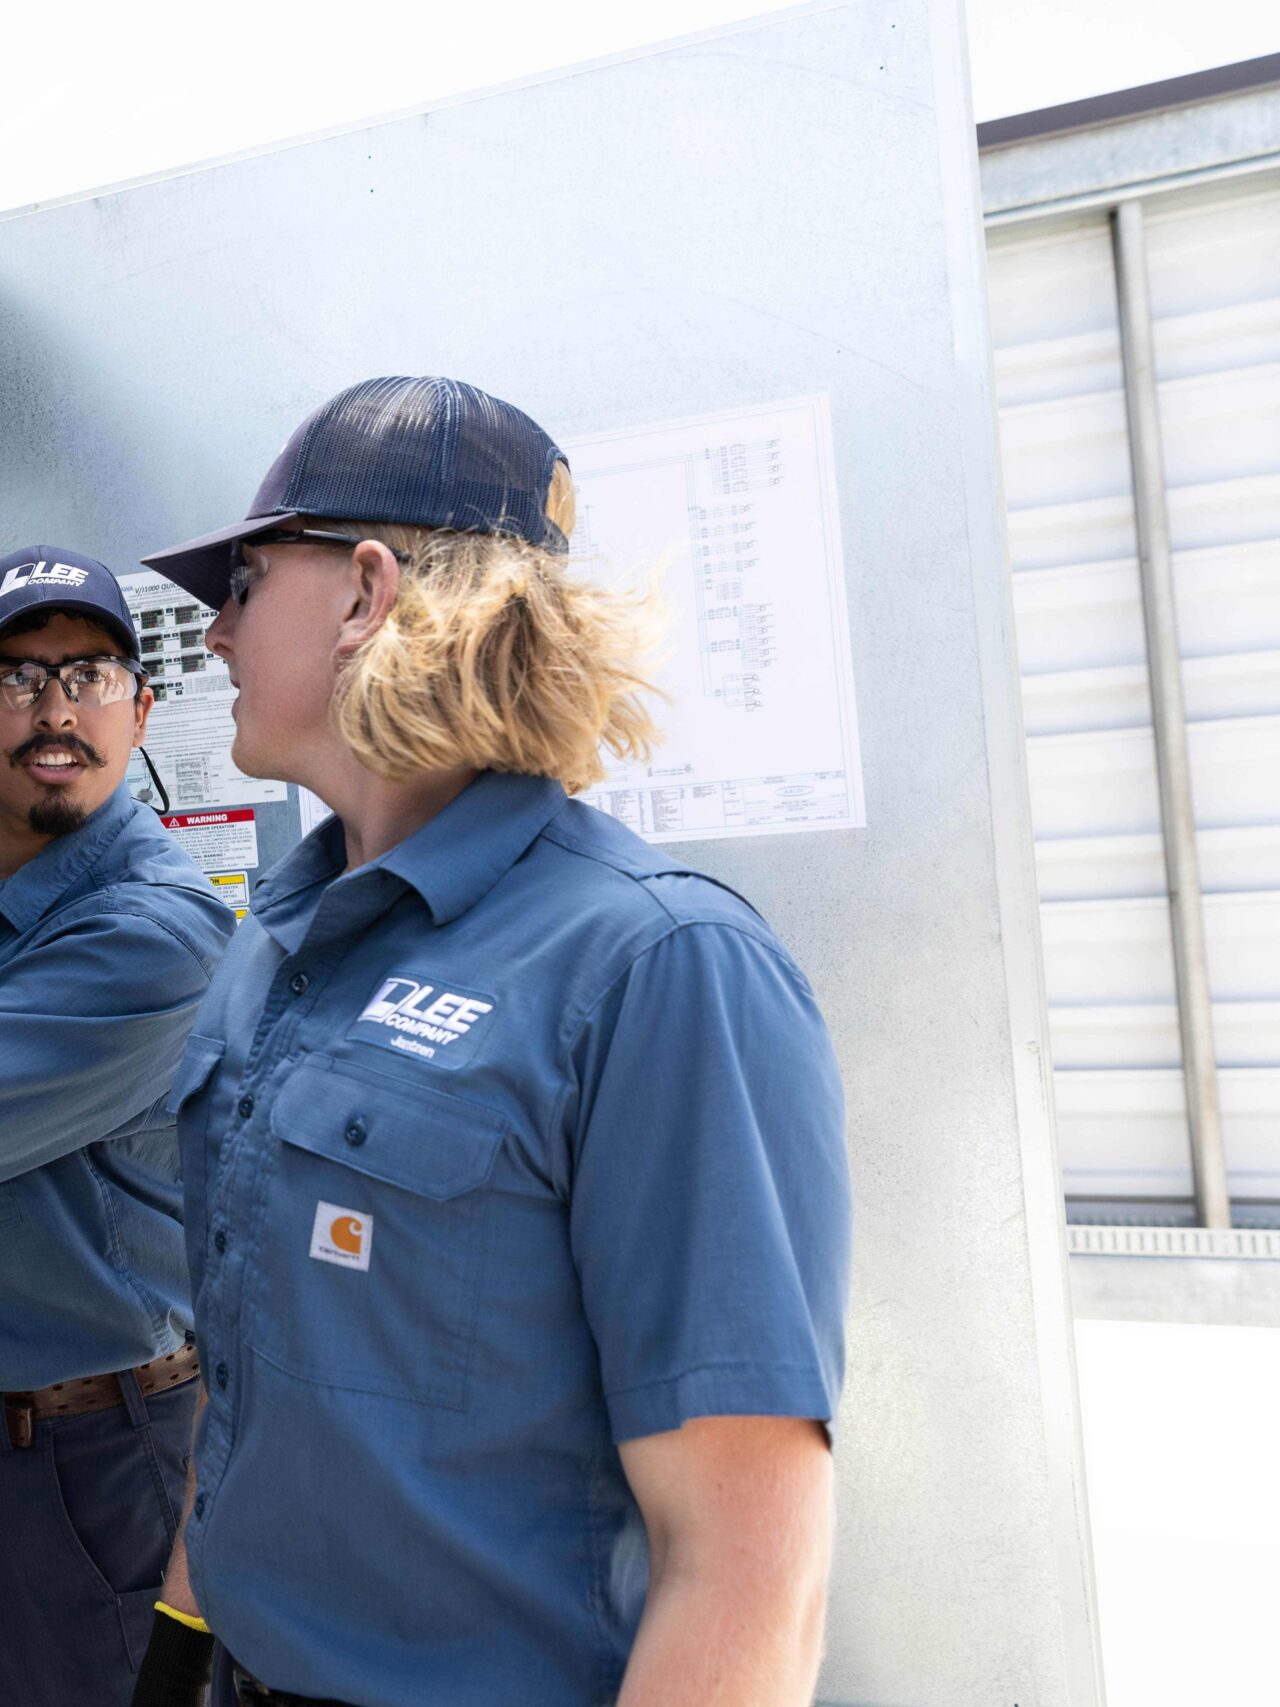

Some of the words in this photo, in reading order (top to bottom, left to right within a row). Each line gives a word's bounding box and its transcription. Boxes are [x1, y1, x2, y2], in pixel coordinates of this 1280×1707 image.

[31, 562, 89, 582] LEE
[28, 578, 83, 587] COMPANY
[186, 814, 228, 825] WARNING
[396, 985, 493, 1034] LEE
[385, 1013, 459, 1045] COMPANY
